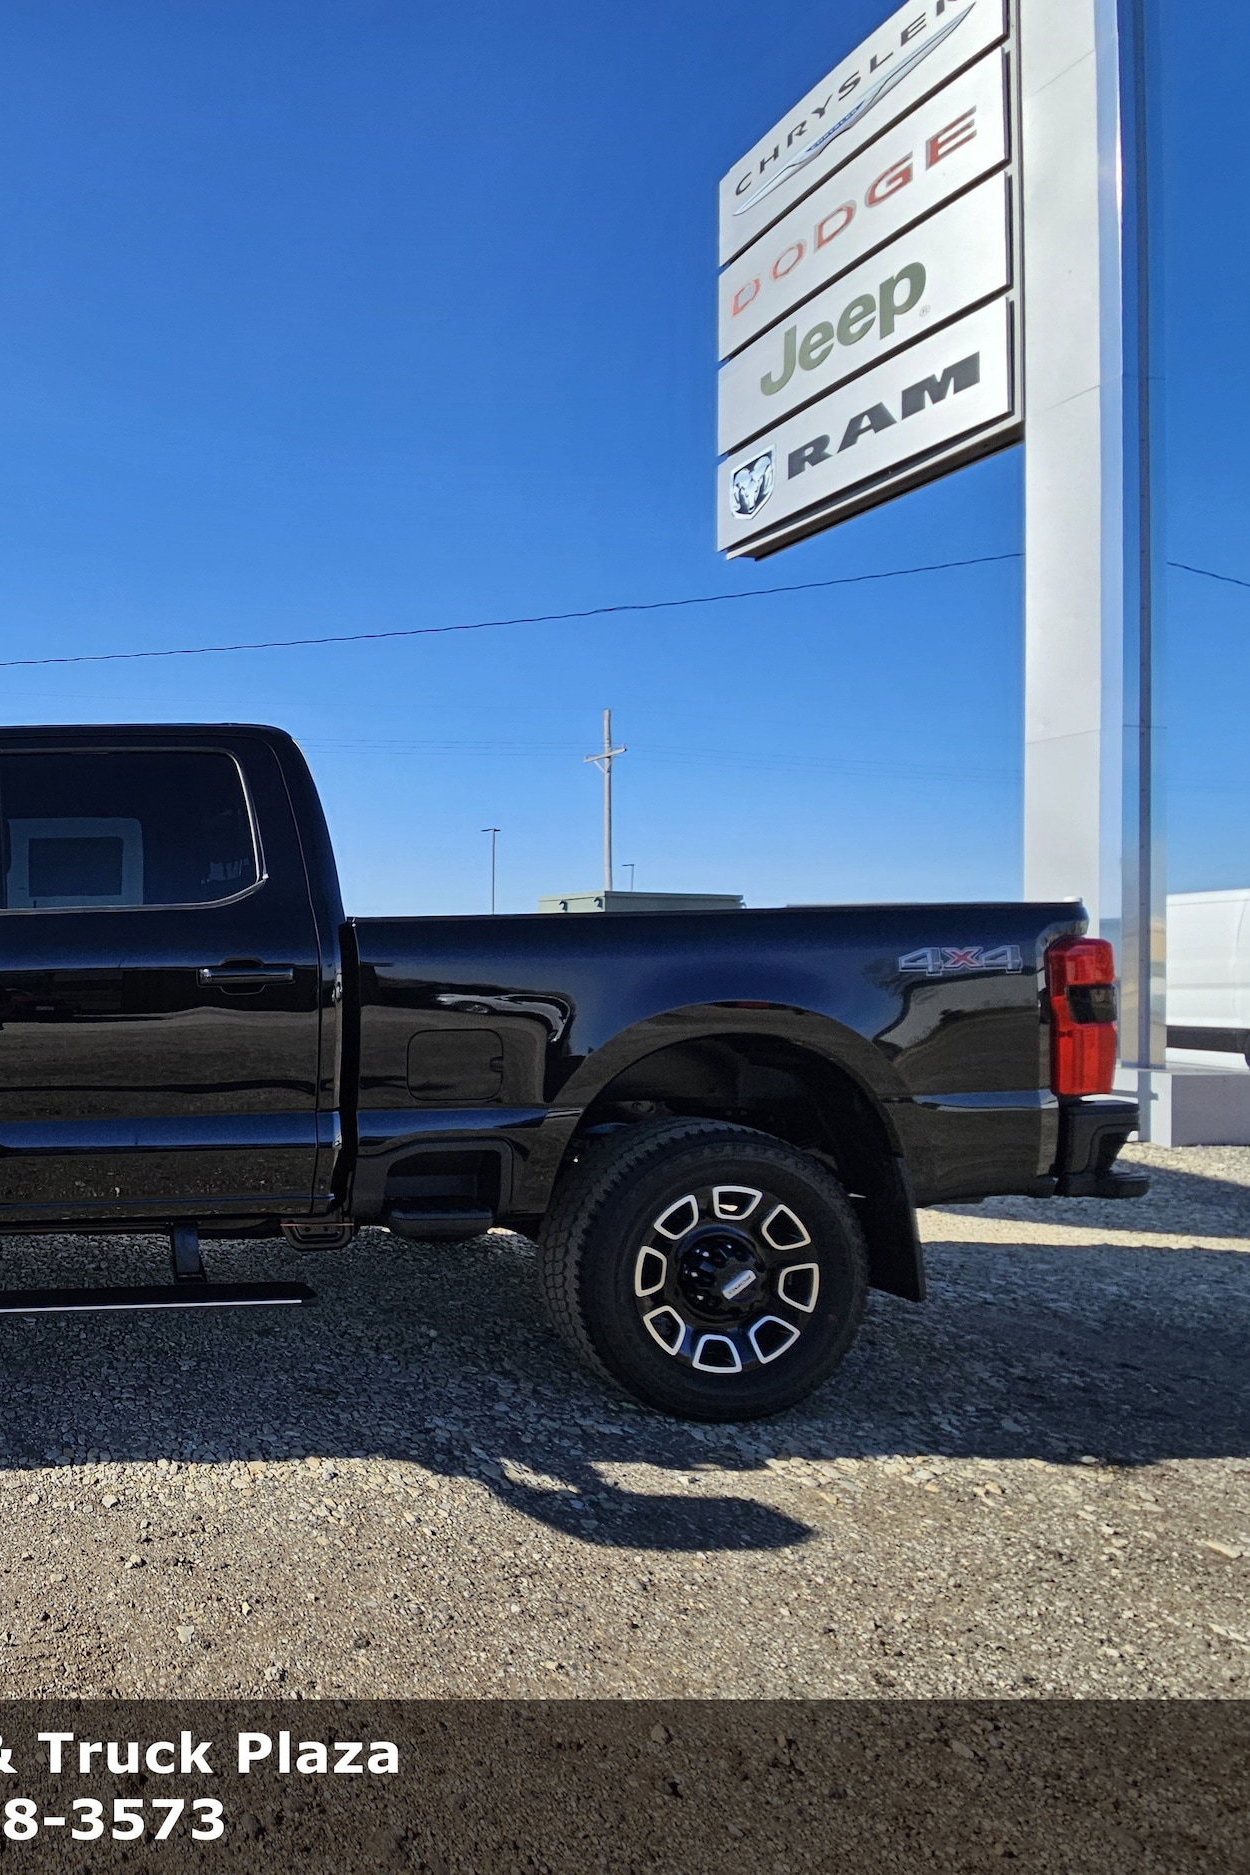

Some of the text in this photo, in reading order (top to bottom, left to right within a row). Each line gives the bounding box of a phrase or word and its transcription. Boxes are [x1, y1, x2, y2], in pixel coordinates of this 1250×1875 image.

[731, 105, 977, 318] DODGE
[760, 261, 927, 396] Jeep
[787, 351, 981, 480] RAM
